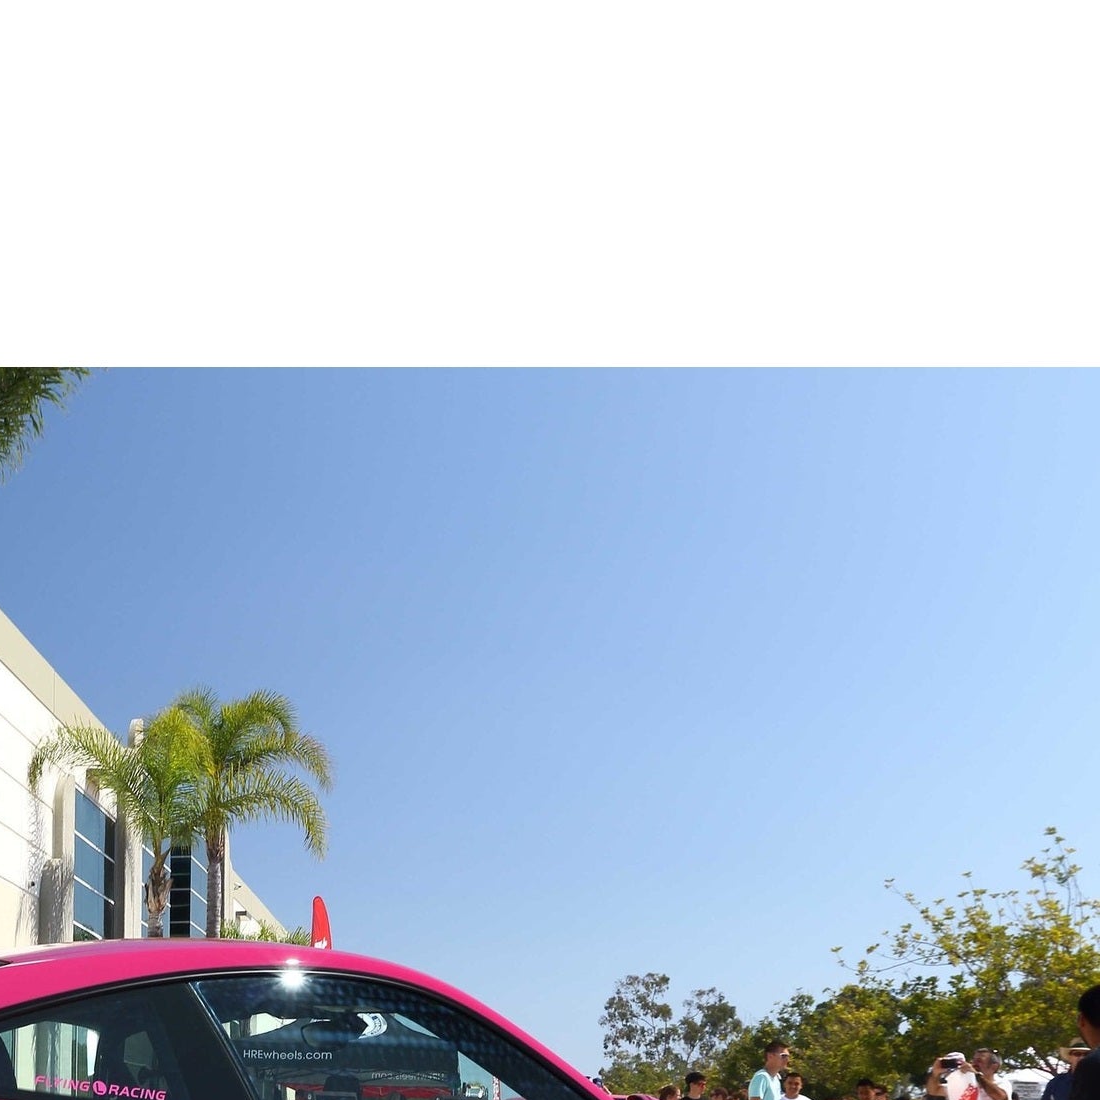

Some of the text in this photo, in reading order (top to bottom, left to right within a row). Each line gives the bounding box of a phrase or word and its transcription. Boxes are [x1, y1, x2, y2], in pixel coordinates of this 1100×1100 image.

[243, 1049, 333, 1060] HREwheels.com
[35, 1075, 90, 1092] FLYING
[108, 1084, 167, 1100] RACING
